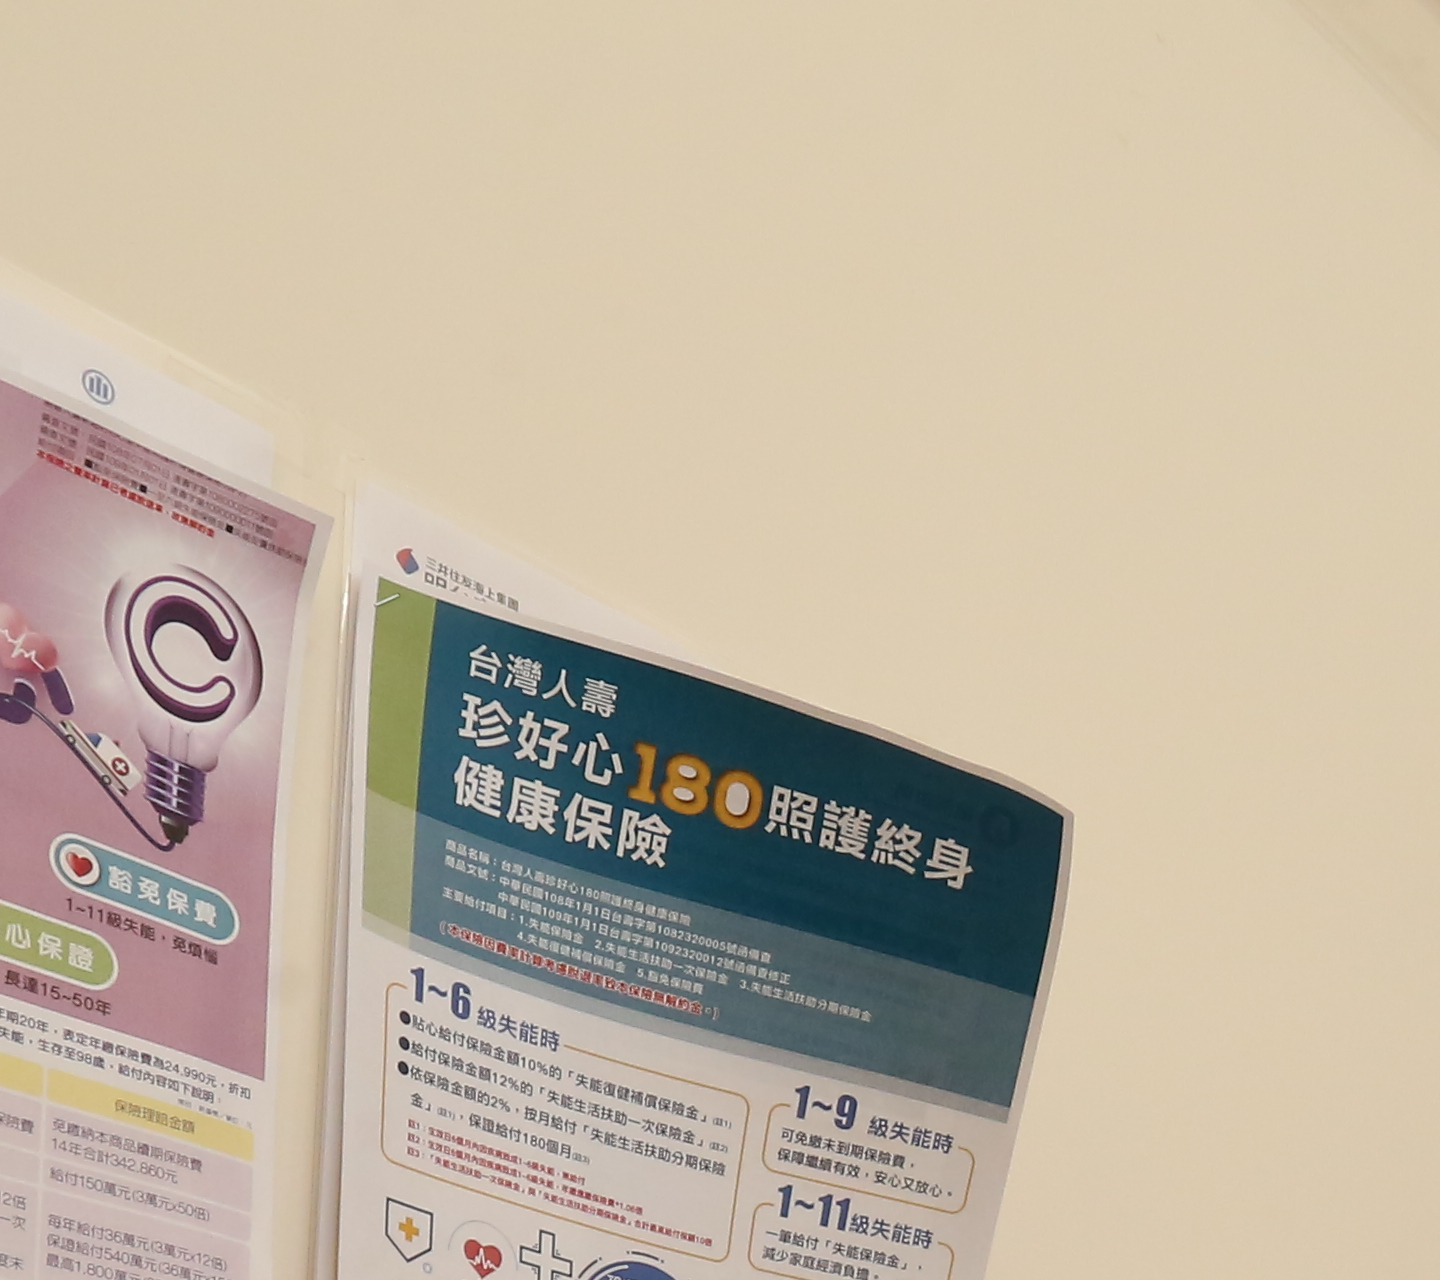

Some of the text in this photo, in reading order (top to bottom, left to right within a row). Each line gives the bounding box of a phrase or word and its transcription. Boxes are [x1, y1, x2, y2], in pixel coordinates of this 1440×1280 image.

[424, 556, 520, 612] 三井住友海上集團
[124, 572, 240, 721] C
[468, 643, 619, 719] 台灣人壽
[452, 755, 673, 869] 健康保險
[457, 692, 975, 891] 珍好心180照護終身
[106, 863, 219, 928] 豁免保費
[65, 897, 219, 967] 1~11級失能，免煩惱
[113, 1098, 197, 1137] 保險理賠金額
[777, 1183, 934, 1250] 1~11級失能時
